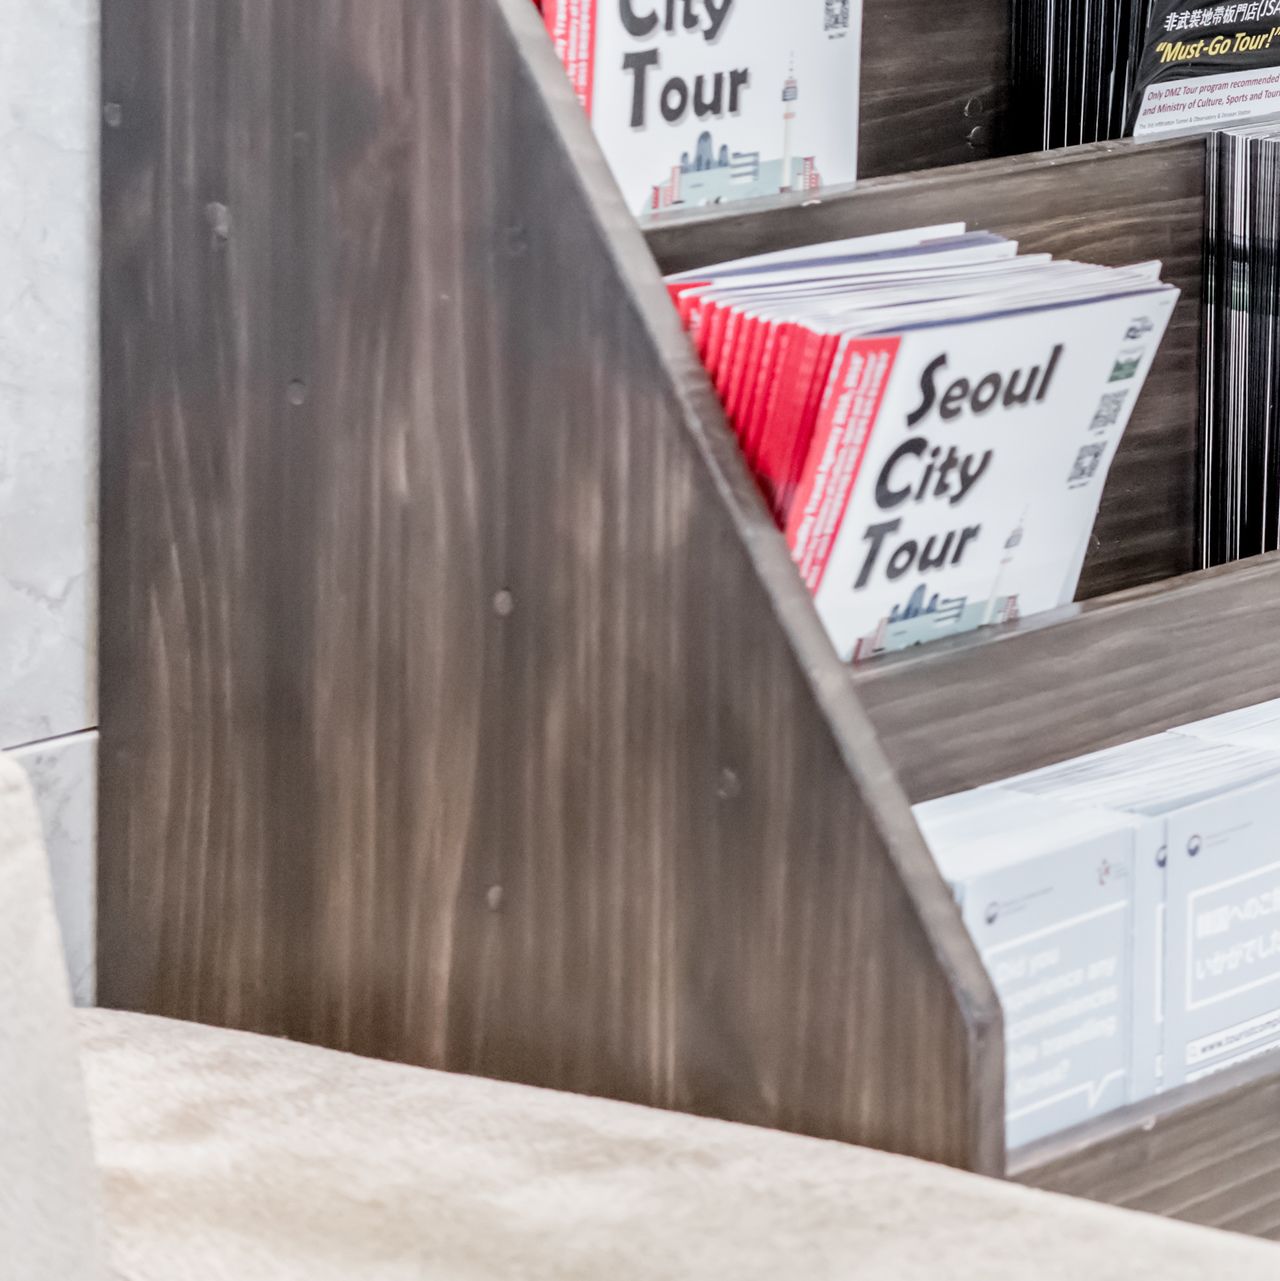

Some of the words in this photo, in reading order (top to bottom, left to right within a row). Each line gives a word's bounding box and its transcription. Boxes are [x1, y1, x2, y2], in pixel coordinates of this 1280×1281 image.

[623, 48, 748, 128] Tour
[1142, 106, 1156, 117] and
[1157, 100, 1187, 114] Ministry
[1188, 99, 1196, 110] of
[1196, 97, 1224, 108] Culture,
[1226, 94, 1248, 106] Sports
[1250, 91, 1263, 101] and
[1147, 90, 1163, 101] Only
[1164, 87, 1181, 97] DMZ
[1183, 85, 1198, 95] Tour
[1199, 83, 1229, 94] program
[1230, 76, 1280, 89] recommended
[907, 343, 1064, 427] Seoul
[874, 437, 993, 508] City
[854, 517, 981, 589] Tour
